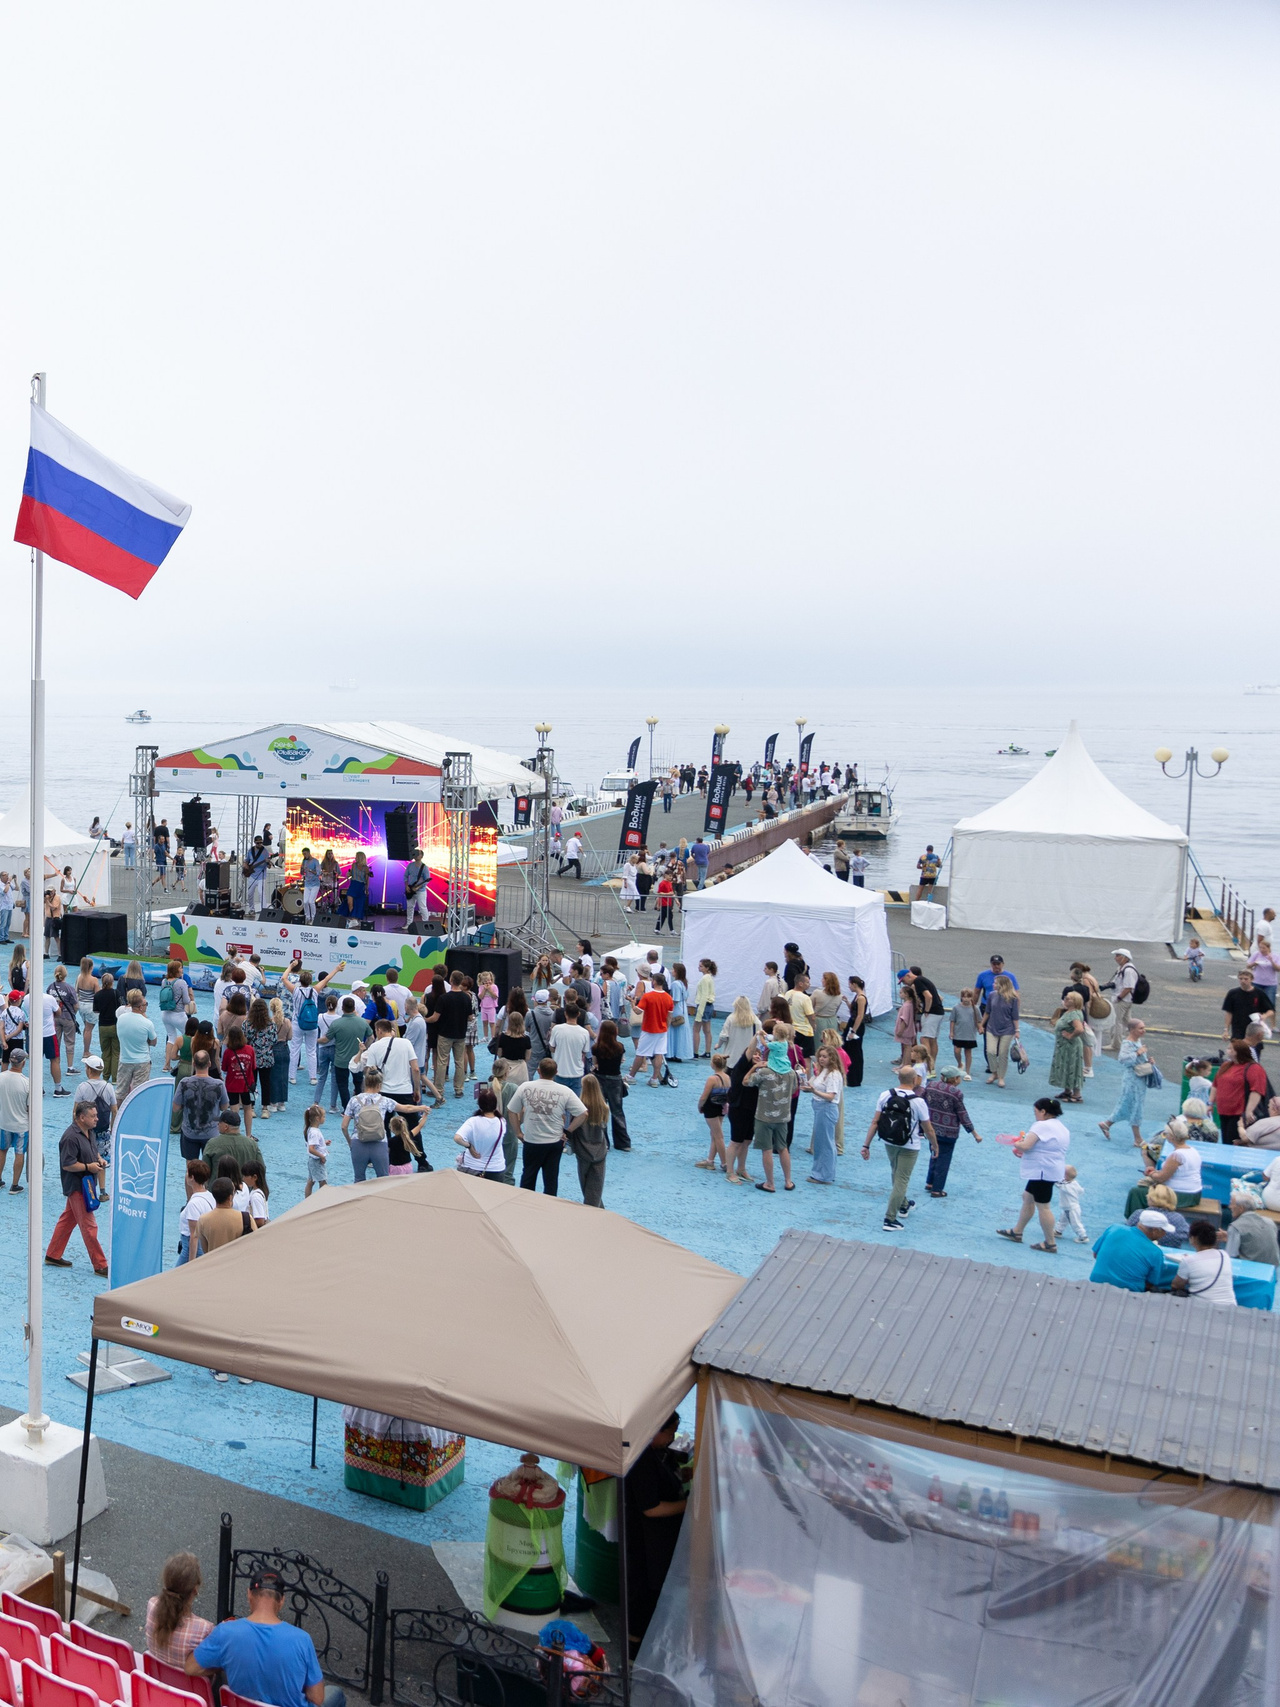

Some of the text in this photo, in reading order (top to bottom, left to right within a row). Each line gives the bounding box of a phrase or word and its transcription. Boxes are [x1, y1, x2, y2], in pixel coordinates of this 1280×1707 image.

[712, 775, 723, 804] Водник
[629, 795, 642, 829] Водник
[303, 950, 323, 958] Водник
